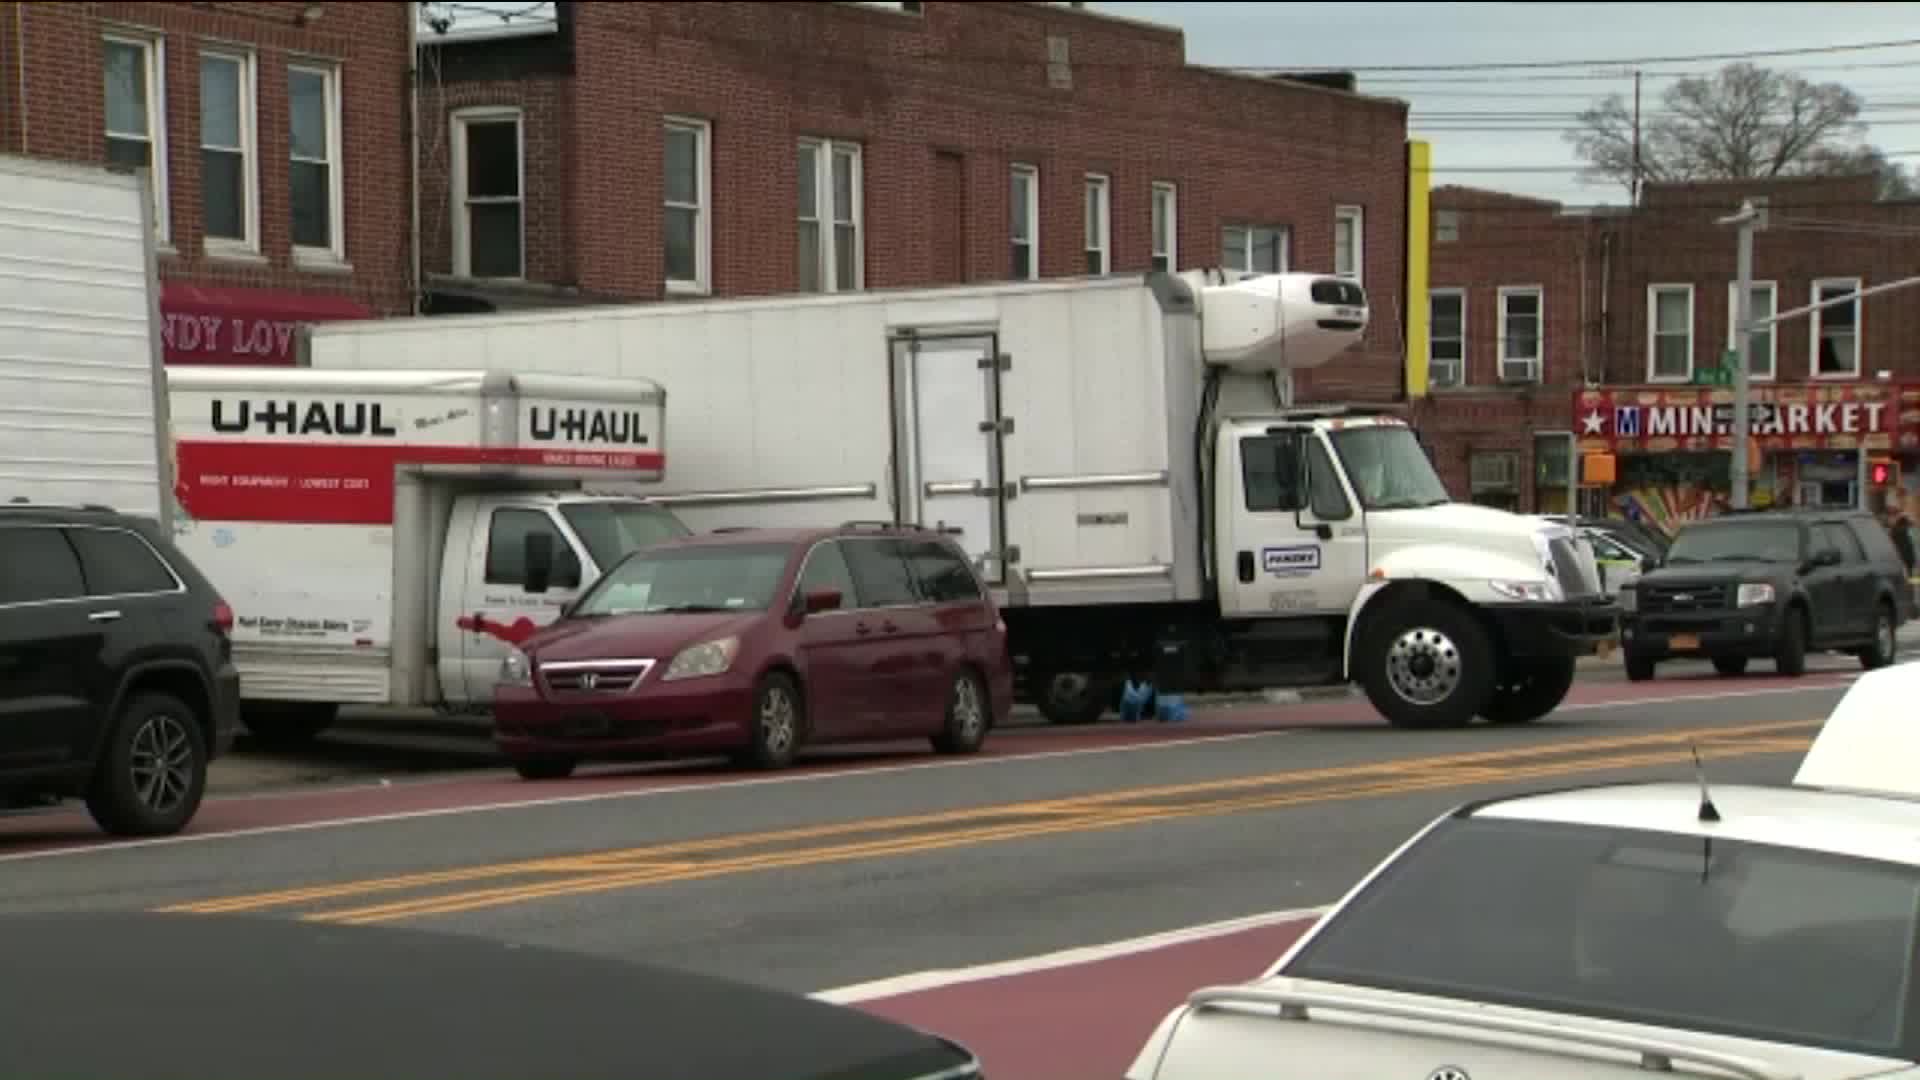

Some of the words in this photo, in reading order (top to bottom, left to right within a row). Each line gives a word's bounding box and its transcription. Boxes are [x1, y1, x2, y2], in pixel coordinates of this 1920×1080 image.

[232, 319, 302, 357] LOV
[212, 399, 396, 437] U-HAUL
[530, 406, 648, 444] U-HAUL
